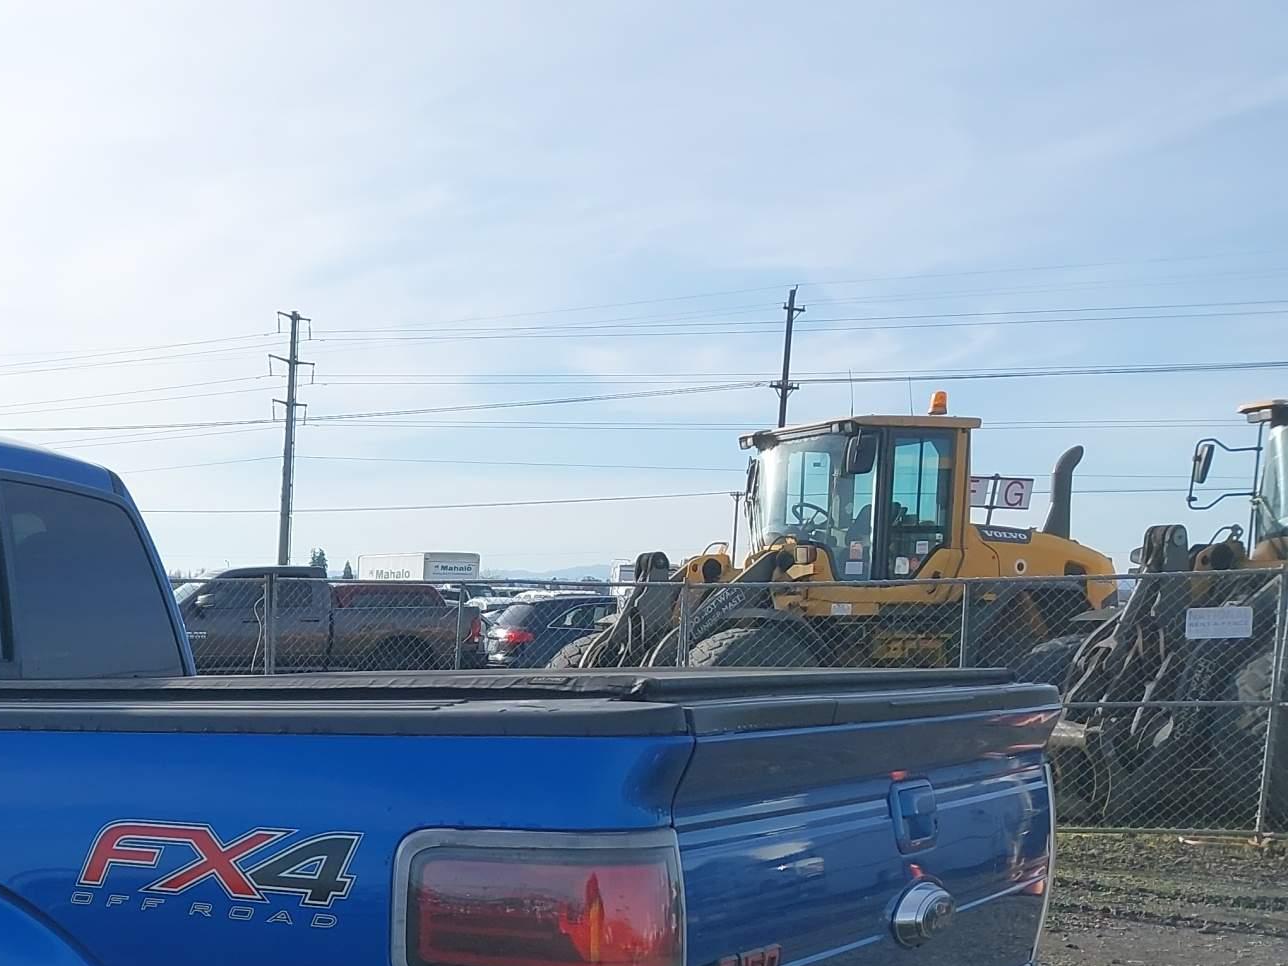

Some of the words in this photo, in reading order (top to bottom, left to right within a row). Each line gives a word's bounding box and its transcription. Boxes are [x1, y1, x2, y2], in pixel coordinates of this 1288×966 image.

[1004, 480, 1025, 506] G
[983, 530, 1027, 539] VOLVO
[376, 569, 411, 580] Mahalo
[441, 564, 473, 572] Mahalo
[76, 819, 364, 910] FX4
[71, 891, 166, 912] OFF
[189, 902, 338, 929] ROAD
